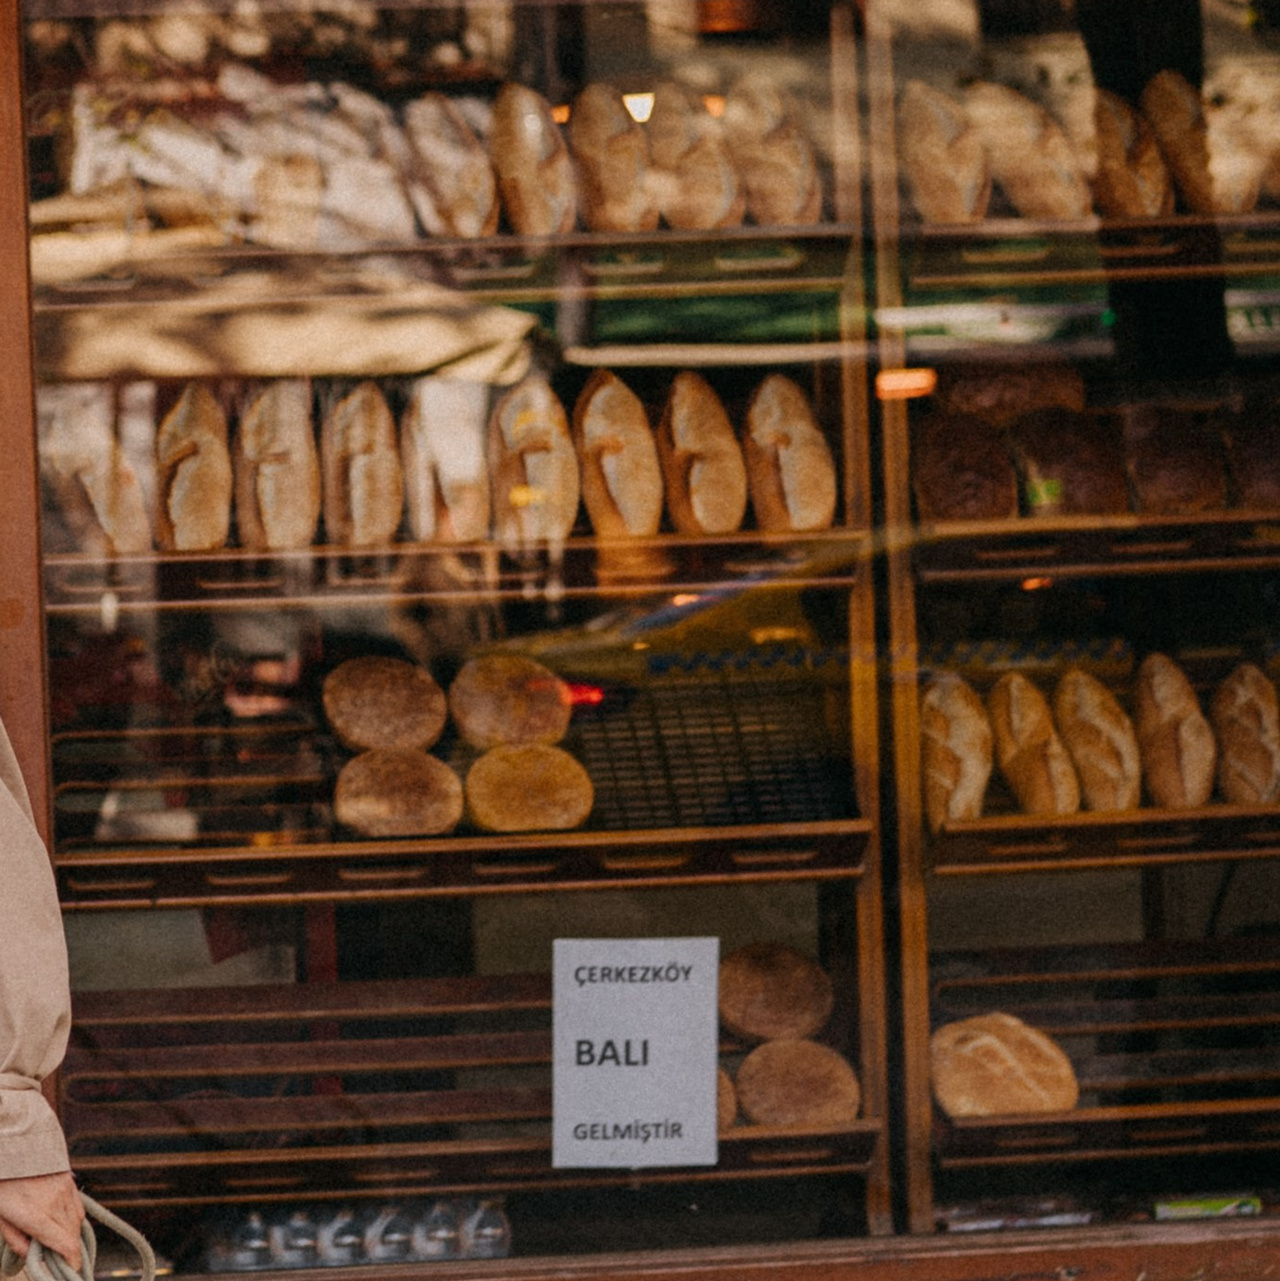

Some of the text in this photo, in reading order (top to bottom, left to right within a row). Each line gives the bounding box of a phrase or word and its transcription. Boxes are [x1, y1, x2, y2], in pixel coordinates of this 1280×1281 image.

[574, 961, 693, 987] ÇERKEZKÖY
[575, 1039, 649, 1067] BALI
[573, 1119, 683, 1144] GELMİŞTİR
